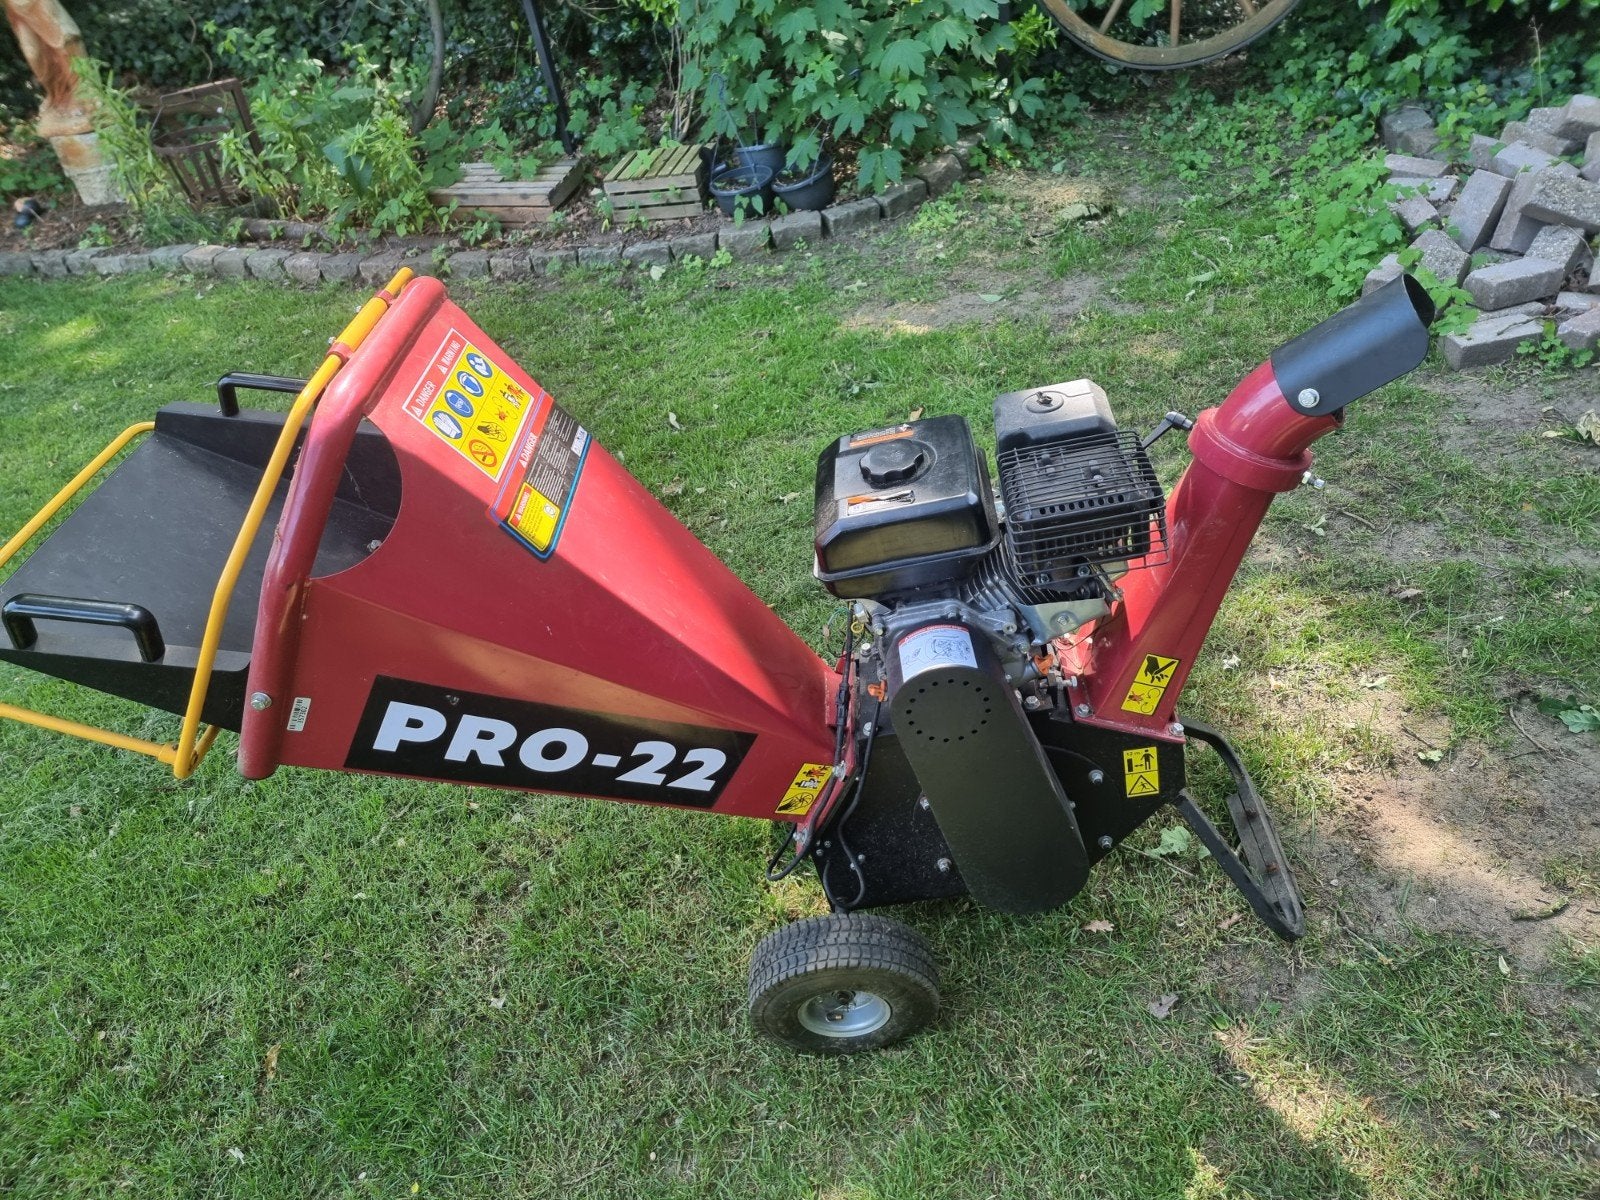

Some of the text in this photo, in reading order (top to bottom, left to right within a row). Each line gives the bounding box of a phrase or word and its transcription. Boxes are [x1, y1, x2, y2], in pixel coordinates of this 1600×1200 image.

[419, 340, 460, 406] DANGER WARNING
[525, 432, 538, 465] DANGER
[372, 700, 727, 792] PRO-22
